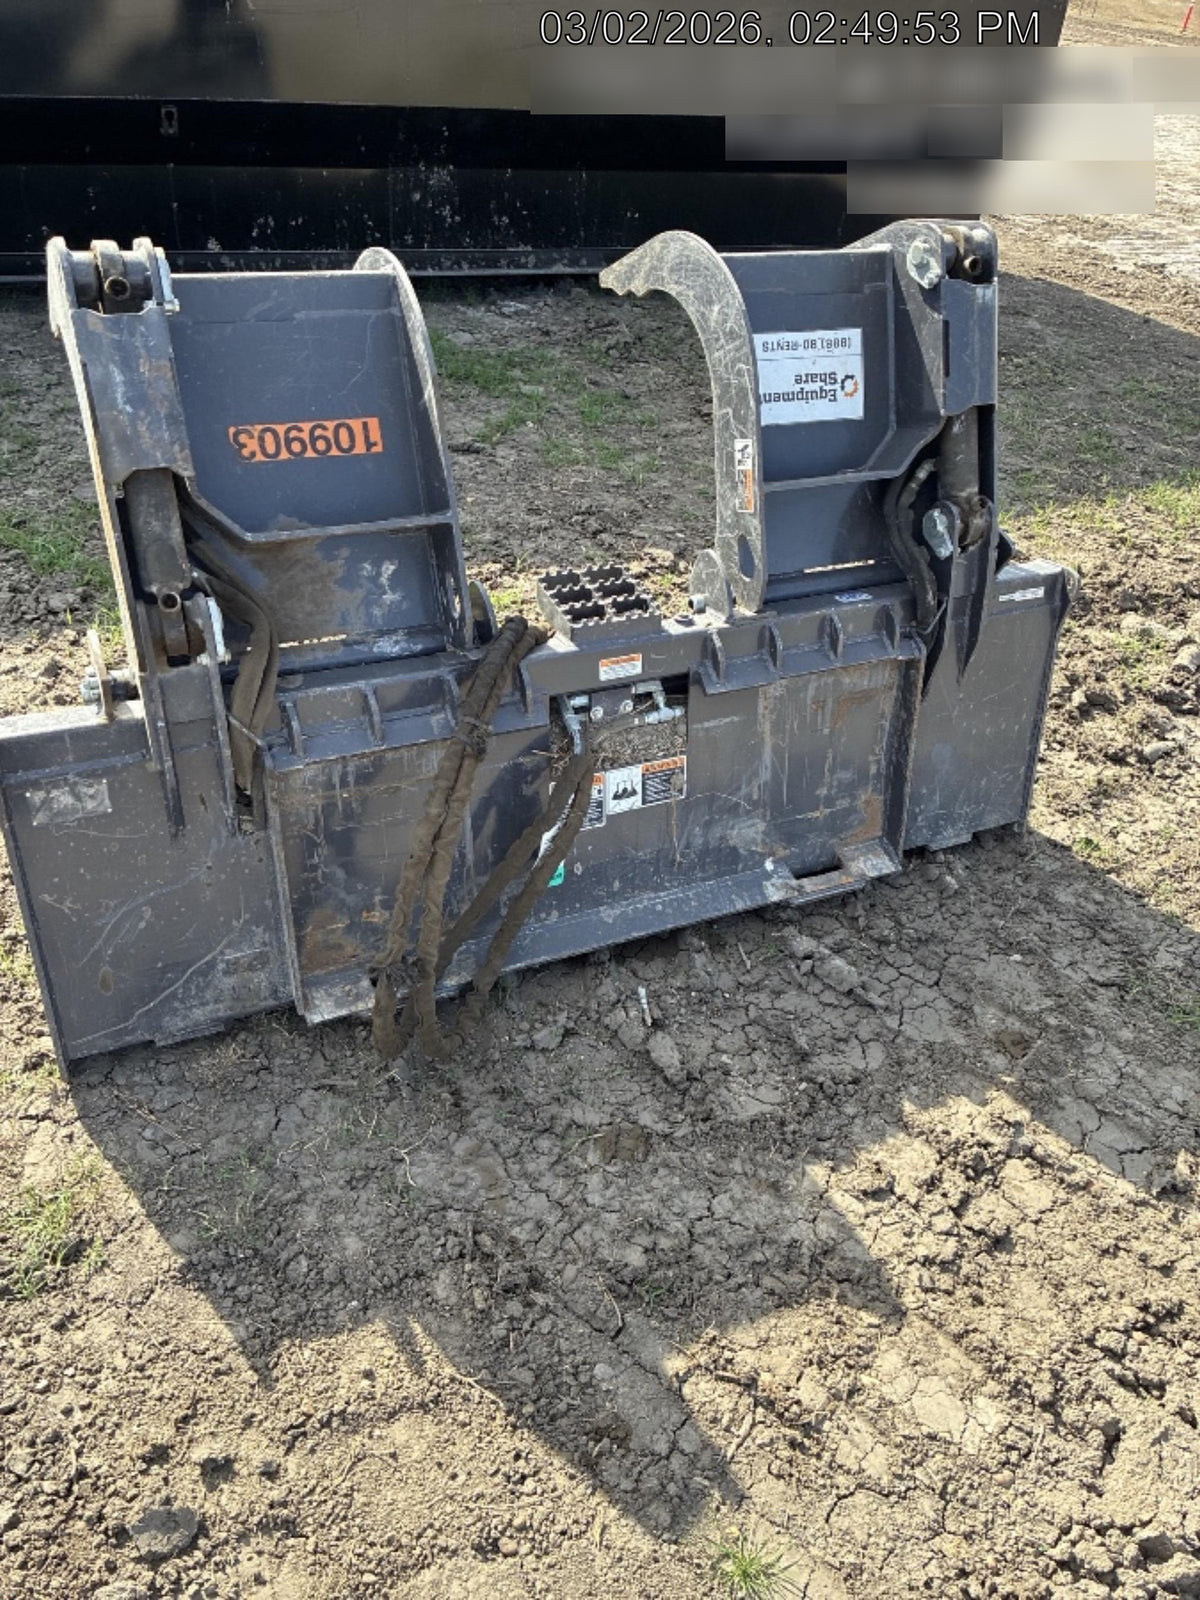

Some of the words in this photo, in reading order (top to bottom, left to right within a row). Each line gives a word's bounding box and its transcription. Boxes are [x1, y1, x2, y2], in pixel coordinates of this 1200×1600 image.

[794, 371, 838, 386] Share
[760, 386, 838, 405] Equipmen
[232, 420, 378, 462] 109903
